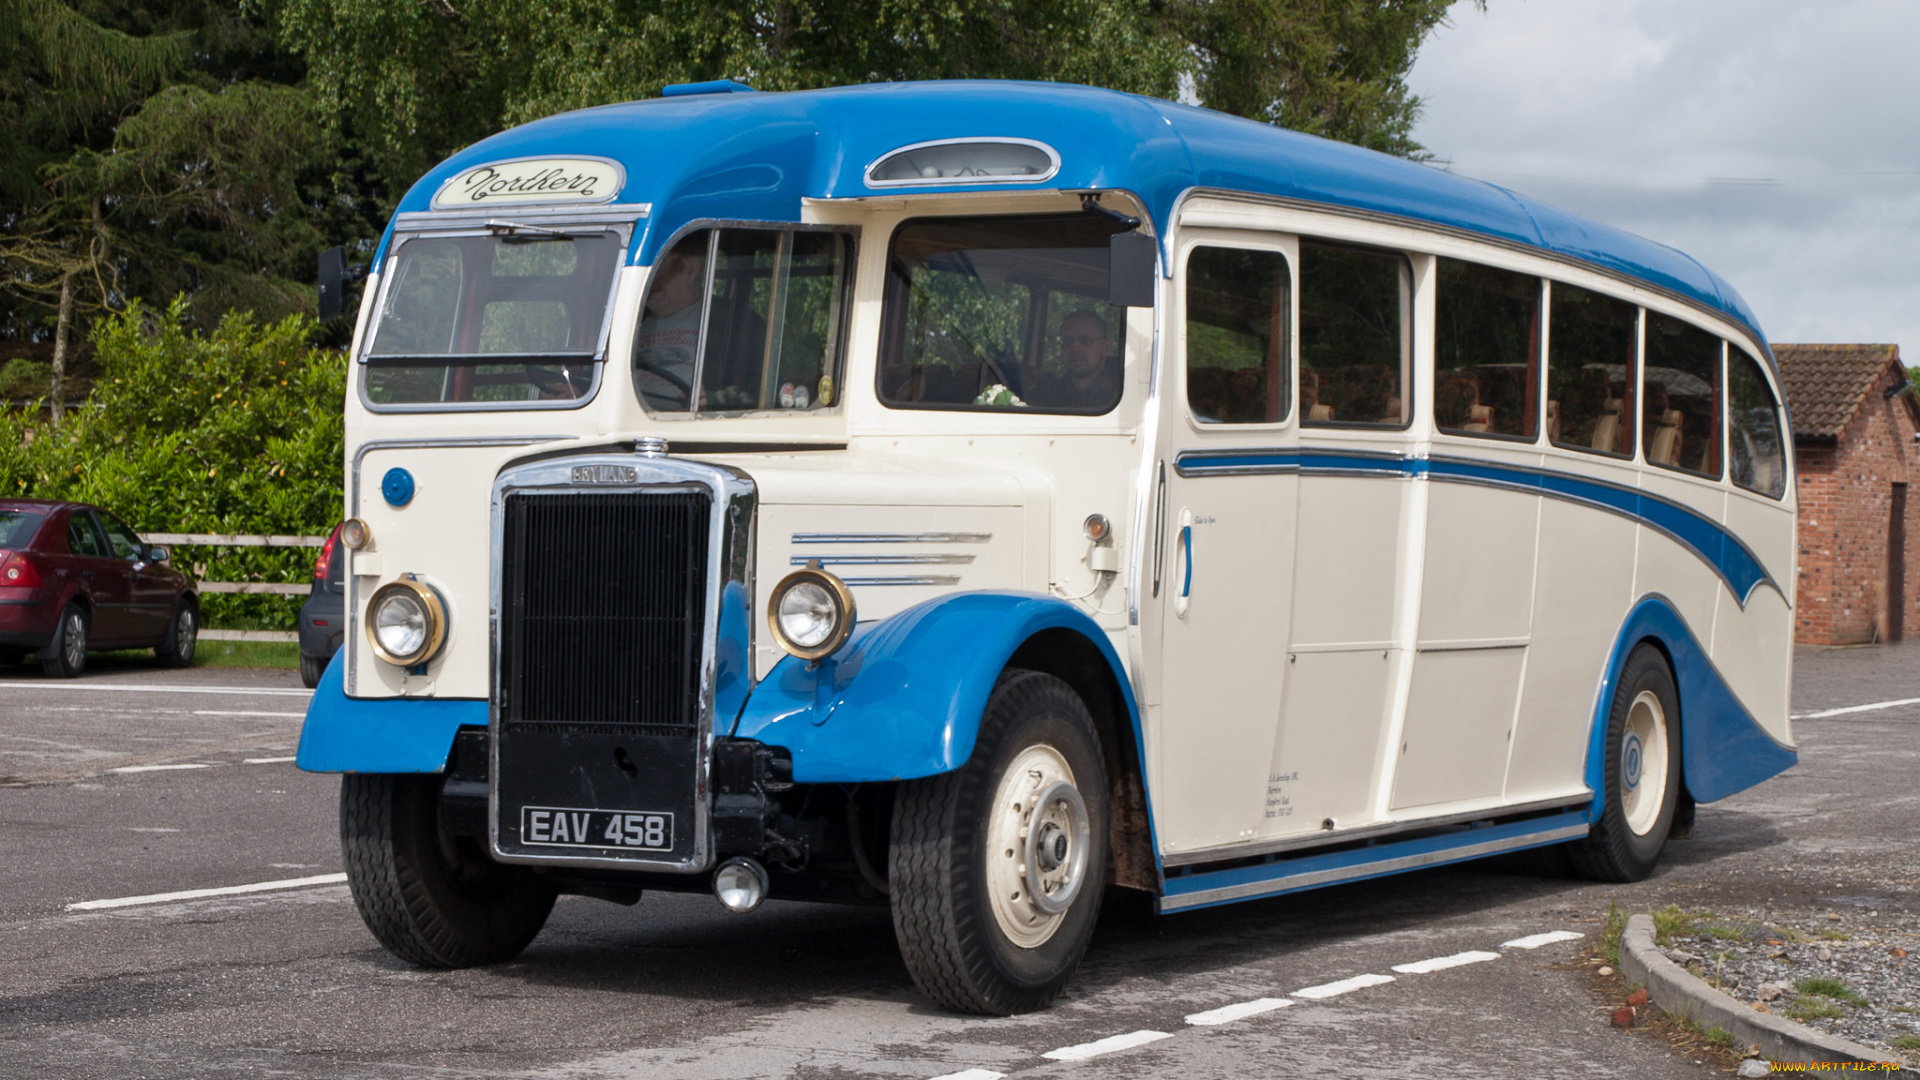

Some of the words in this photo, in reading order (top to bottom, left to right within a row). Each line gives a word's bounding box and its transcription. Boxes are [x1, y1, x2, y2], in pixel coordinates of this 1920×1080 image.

[464, 167, 598, 200] Northern
[530, 811, 590, 842] EAV
[604, 814, 664, 846] 458
